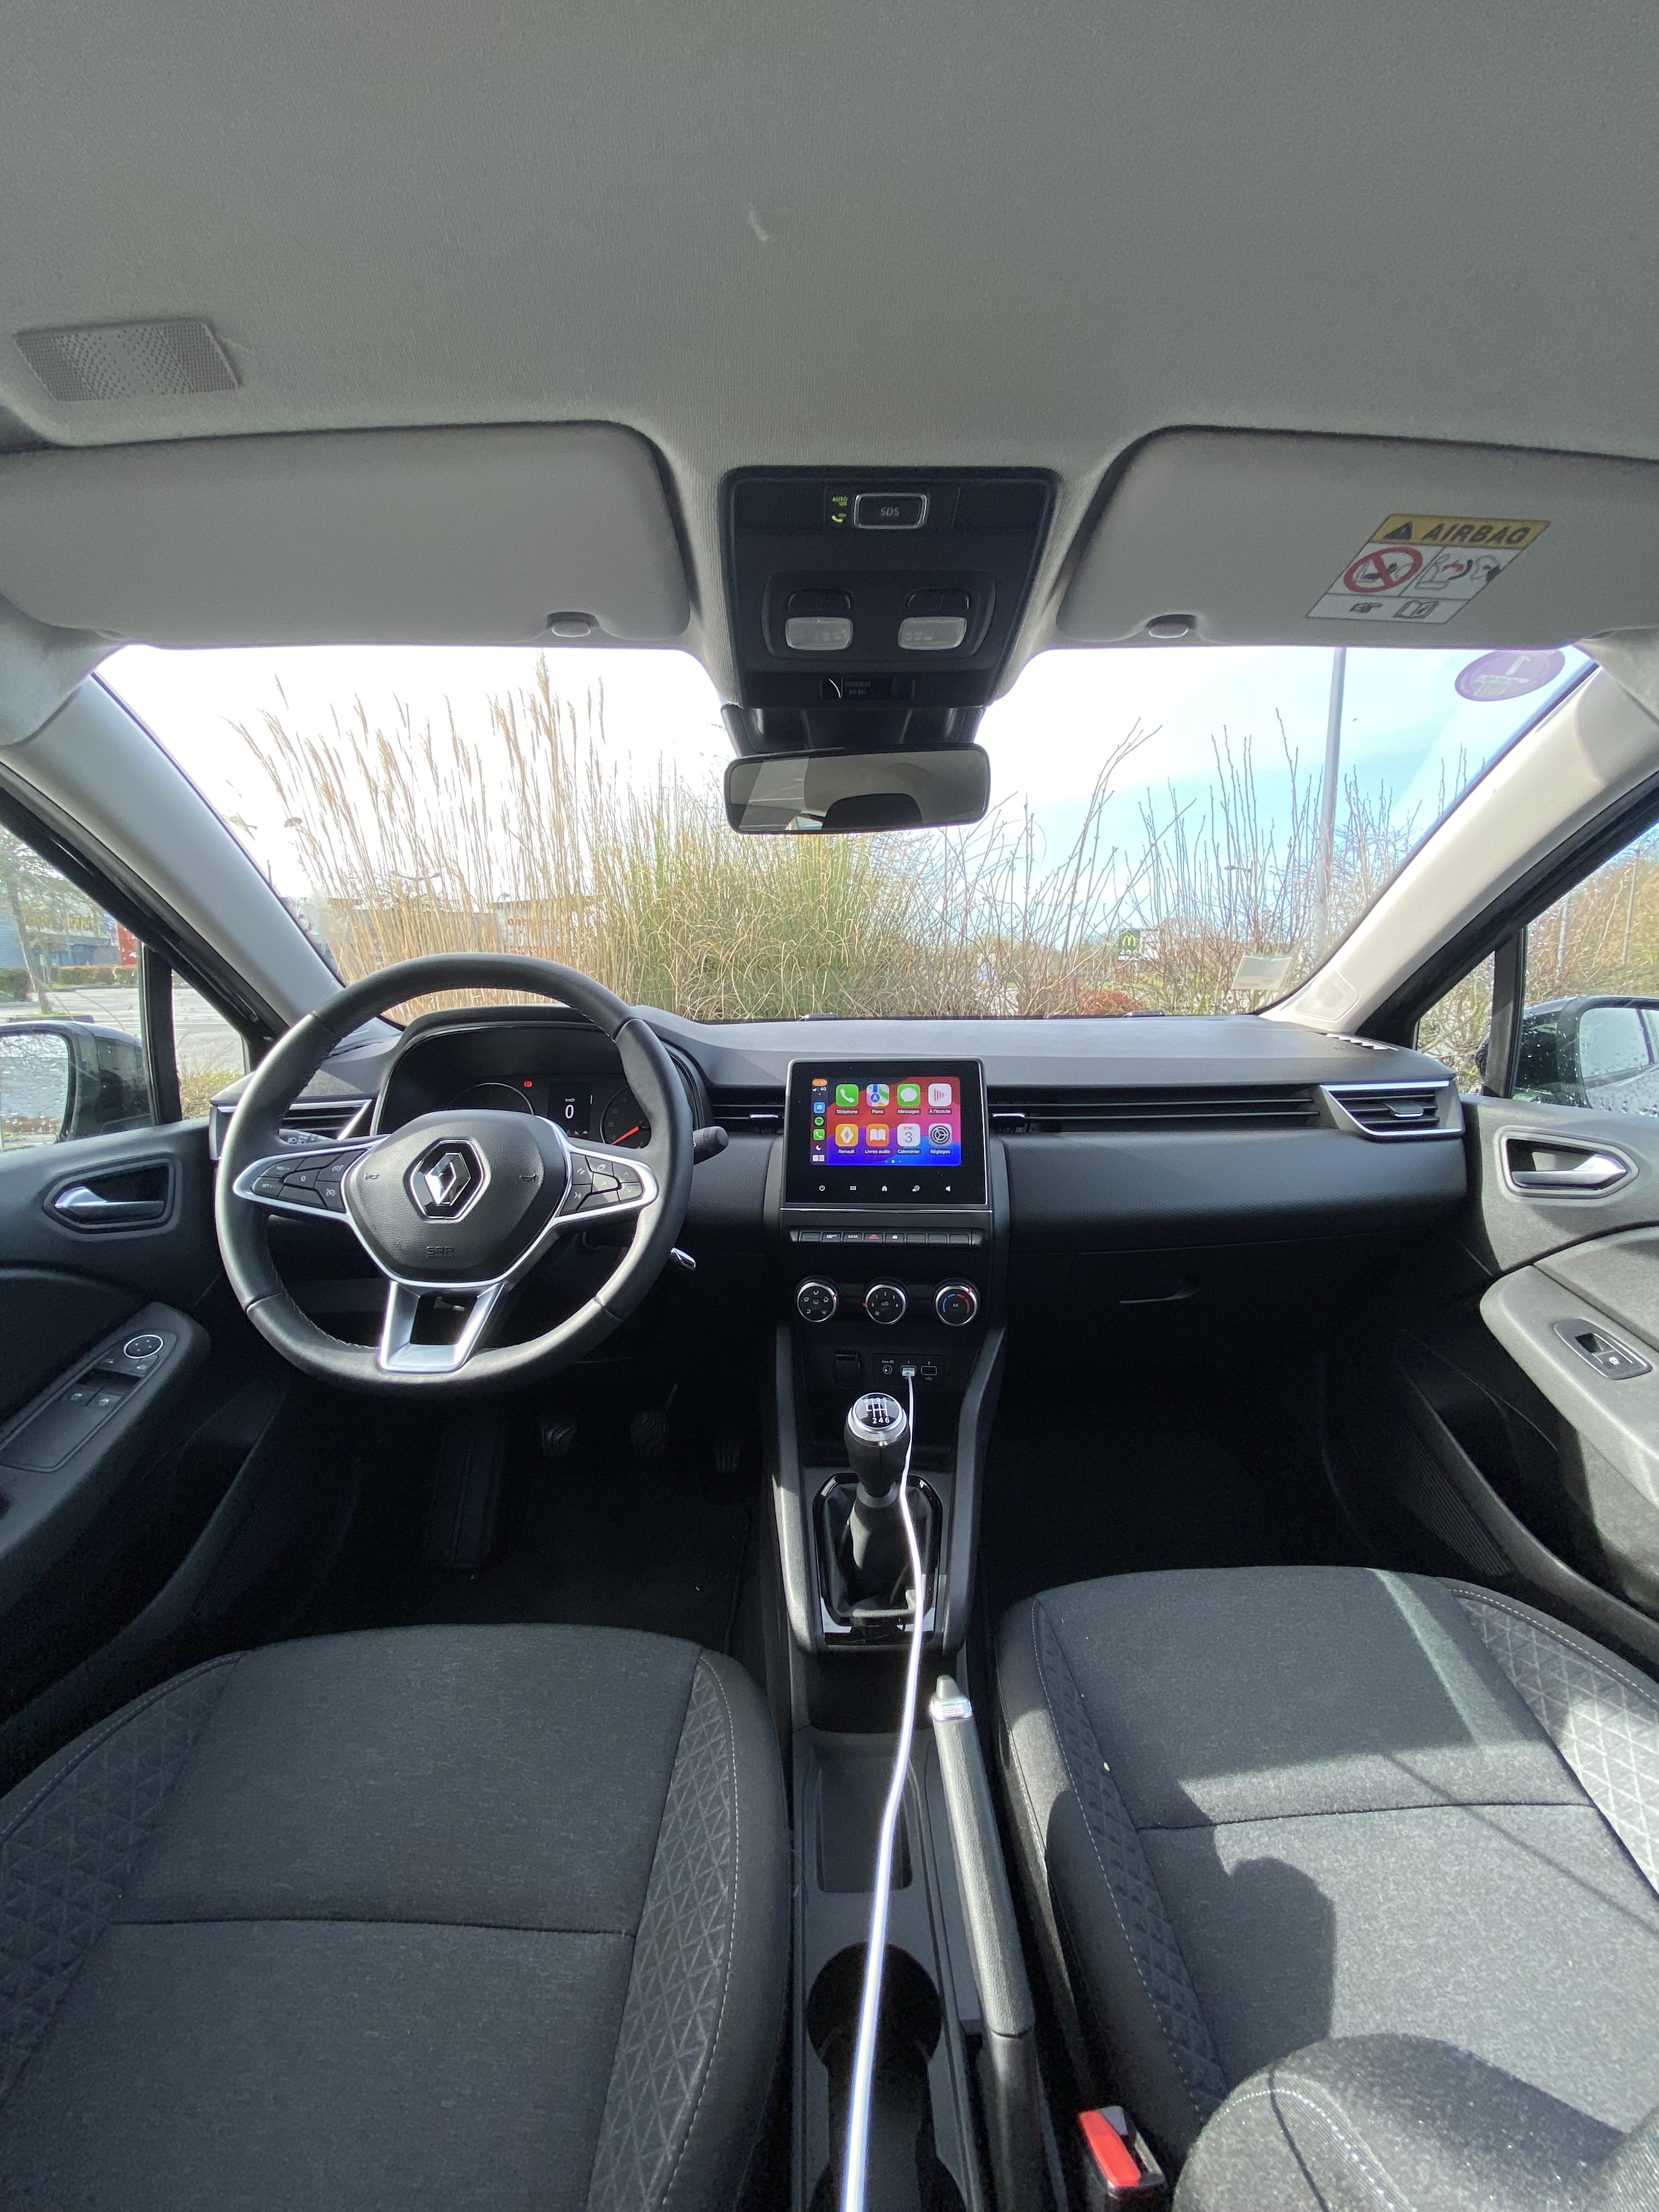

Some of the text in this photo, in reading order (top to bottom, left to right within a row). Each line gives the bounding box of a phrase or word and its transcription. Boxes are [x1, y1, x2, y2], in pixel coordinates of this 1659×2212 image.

[881, 506, 900, 516] SOS
[1421, 522, 1532, 544] AIRBAG
[565, 1104, 574, 1119] 0
[905, 1132, 912, 1143] 3
